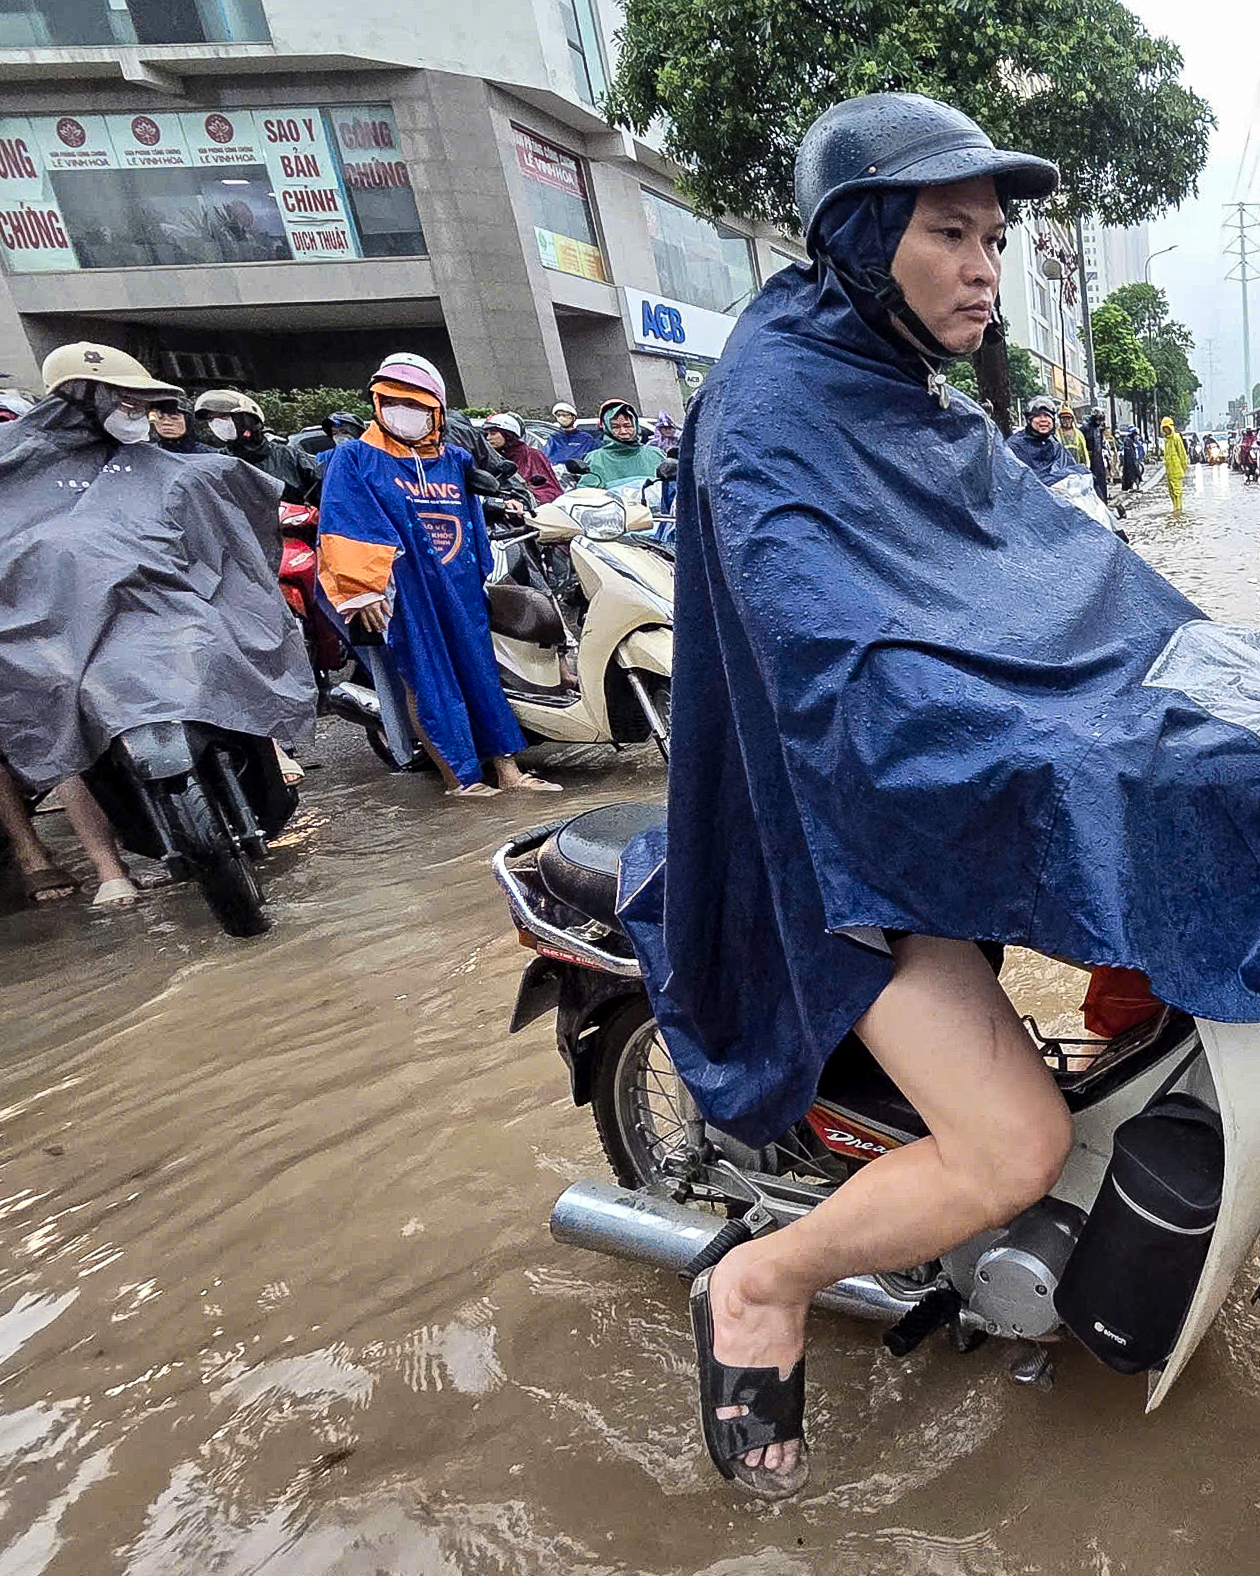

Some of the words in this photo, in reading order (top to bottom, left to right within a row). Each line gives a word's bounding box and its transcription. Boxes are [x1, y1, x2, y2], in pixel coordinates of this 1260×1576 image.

[264, 119, 301, 143] SAO
[303, 118, 316, 142] Y
[280, 147, 321, 178] BẢN
[282, 185, 339, 213] CHÍNH
[0, 202, 68, 250] CHỨNG
[291, 230, 318, 255] DỊCH
[316, 227, 349, 254] THUẬT
[642, 300, 685, 343] ACB
[824, 1127, 889, 1153] Drea
